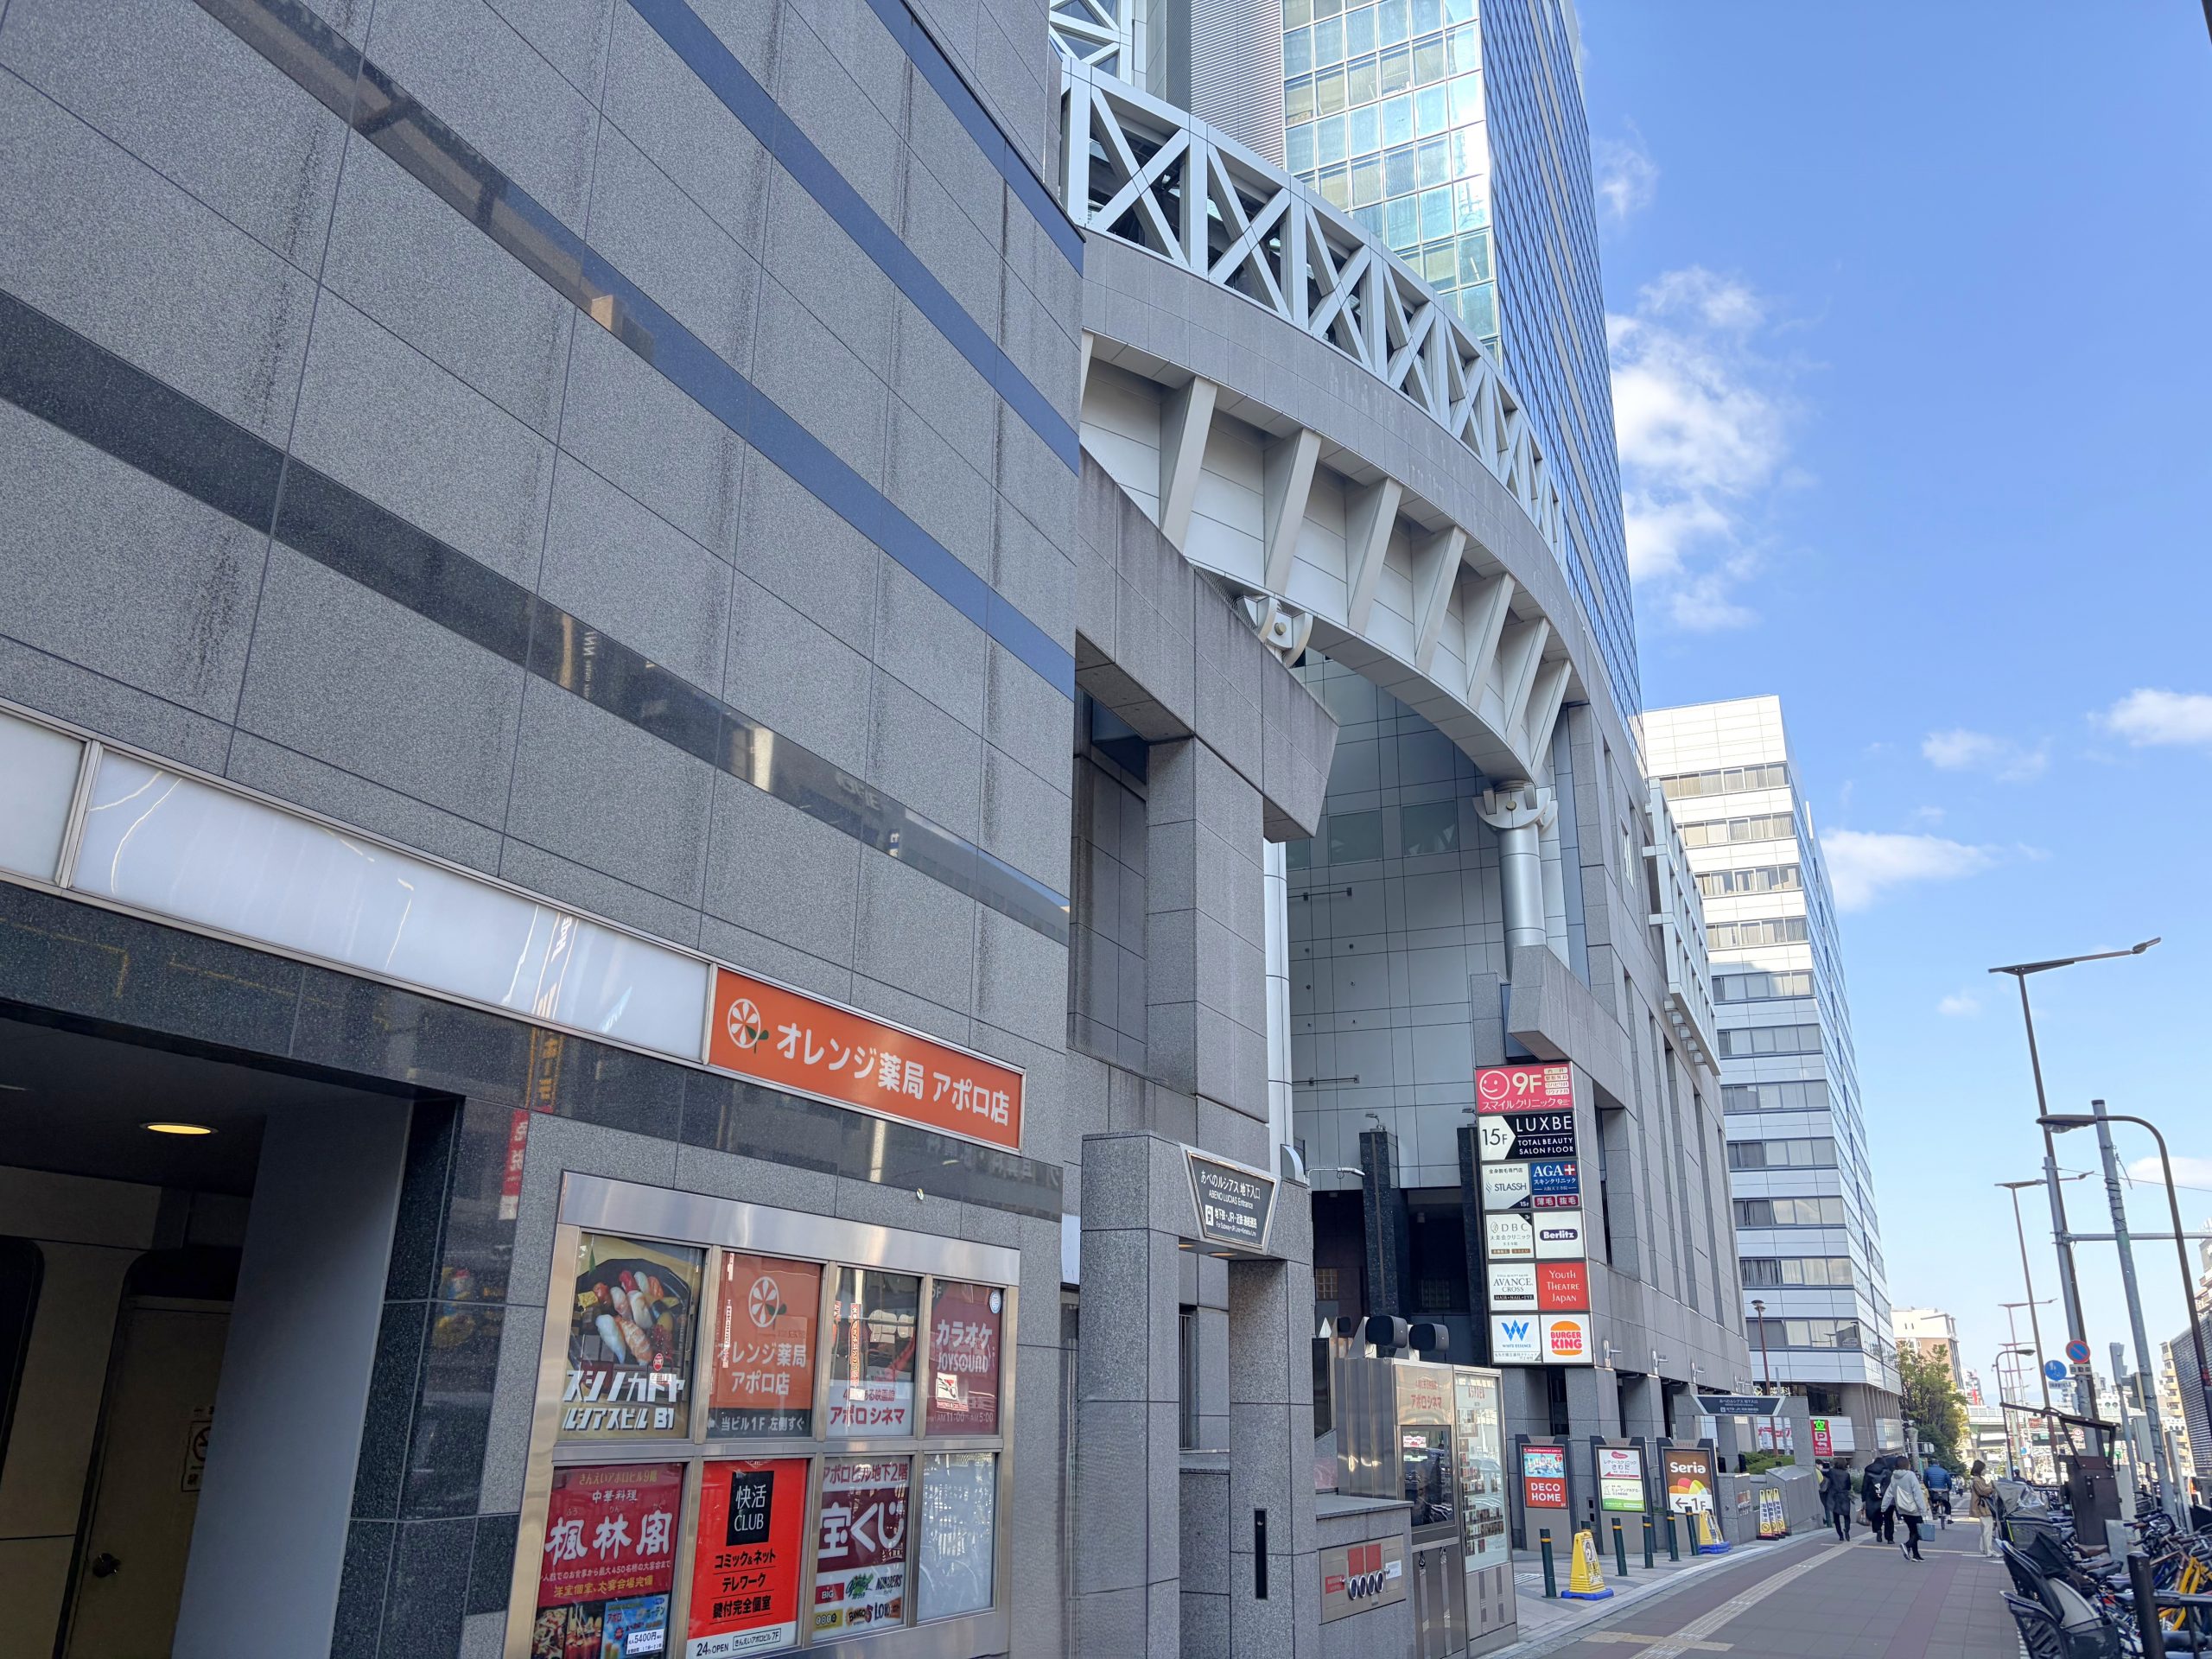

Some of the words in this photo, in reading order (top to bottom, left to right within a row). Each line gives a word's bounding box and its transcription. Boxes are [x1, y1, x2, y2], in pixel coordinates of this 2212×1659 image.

[776, 1022, 924, 1101] オレンジ薬局
[931, 1071, 1009, 1127] アポロ店
[1512, 1072, 1542, 1096] 9F
[1482, 1097, 1555, 1111] スマイルクリニック
[1516, 1116, 1573, 1133] LUXBE
[1482, 1128, 1508, 1146] 15F
[1533, 1165, 1564, 1178] AGA
[1200, 1170, 1239, 1194] あべのルシアス
[1240, 1182, 1261, 1200] 地下入口
[1494, 1182, 1527, 1192] STLASSH
[1534, 1177, 1577, 1185] スキンクリニック
[1209, 1189, 1223, 1201] ABENO
[1543, 1230, 1575, 1239] Berlitz
[936, 1319, 993, 1350] カラオケ
[1551, 1340, 1582, 1349] KING
[937, 1351, 991, 1374] JOYSOUND
[563, 1370, 685, 1402] スシノカドヤ
[732, 1370, 791, 1396] アポロ店
[842, 1388, 895, 1402] 4ある映画館
[562, 1408, 648, 1431] ルシアスビル
[654, 1407, 675, 1430] B1
[770, 1417, 805, 1432] 左側すぐ
[1669, 1461, 1707, 1474] Seria
[1530, 1483, 1560, 1491] DECO
[592, 1490, 638, 1503] 中華料理
[735, 1484, 767, 1510] 快活
[1531, 1493, 1561, 1502] HOME
[734, 1513, 765, 1532] CLUB
[818, 1501, 905, 1559] 宝くじ
[544, 1510, 672, 1566] 楓林閣
[541, 1560, 671, 1583] 人数でのお食事から最大450名様の大宴会まで
[721, 1573, 766, 1592] テレワーク
[875, 1574, 903, 1590] NUMBERS
[822, 1591, 834, 1599] BIG
[712, 1595, 772, 1619] 鍵付完全個室
[849, 1609, 866, 1622] BINGO
[634, 1631, 657, 1643] 5400円
[711, 1643, 729, 1654] OPEN
